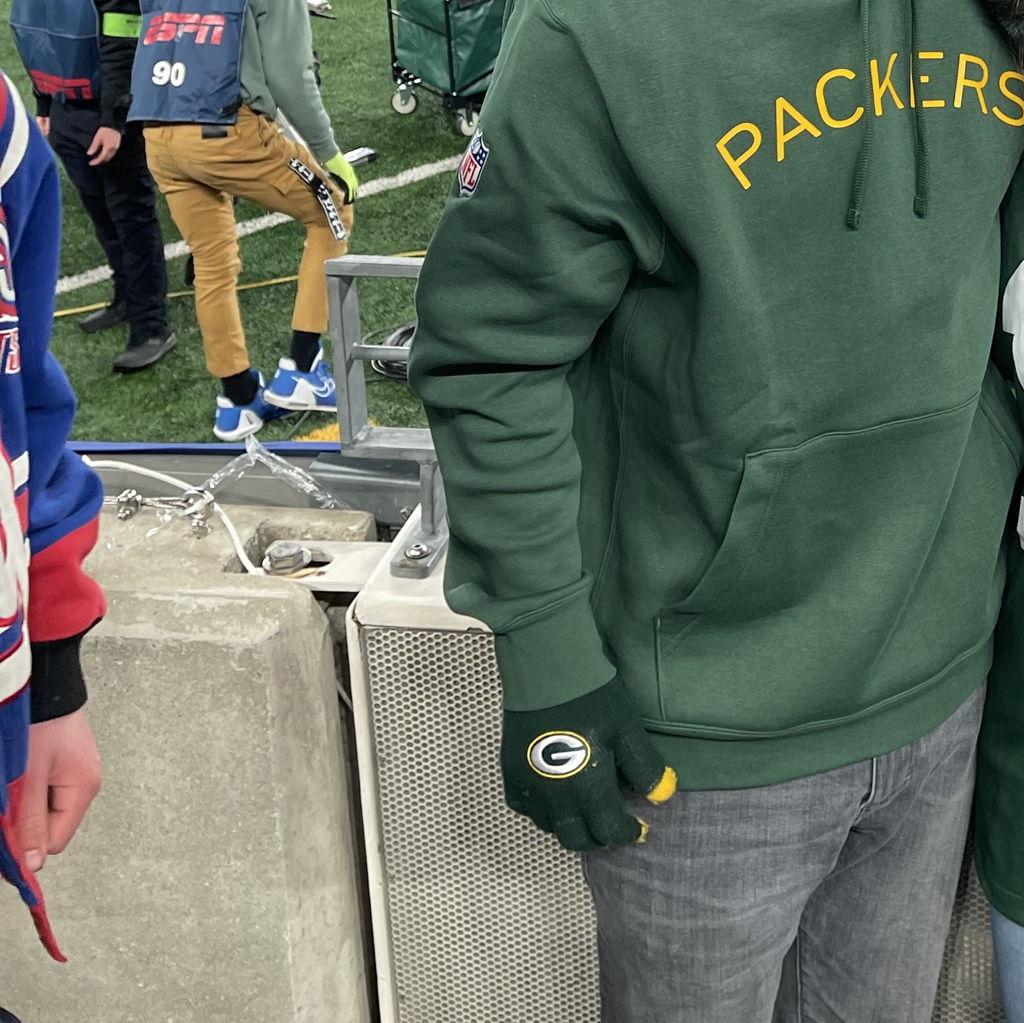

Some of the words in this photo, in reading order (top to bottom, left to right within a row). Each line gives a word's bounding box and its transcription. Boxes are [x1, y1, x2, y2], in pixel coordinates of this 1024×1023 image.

[143, 12, 226, 45] ESPN
[151, 60, 186, 87] 90
[529, 733, 587, 775] G
